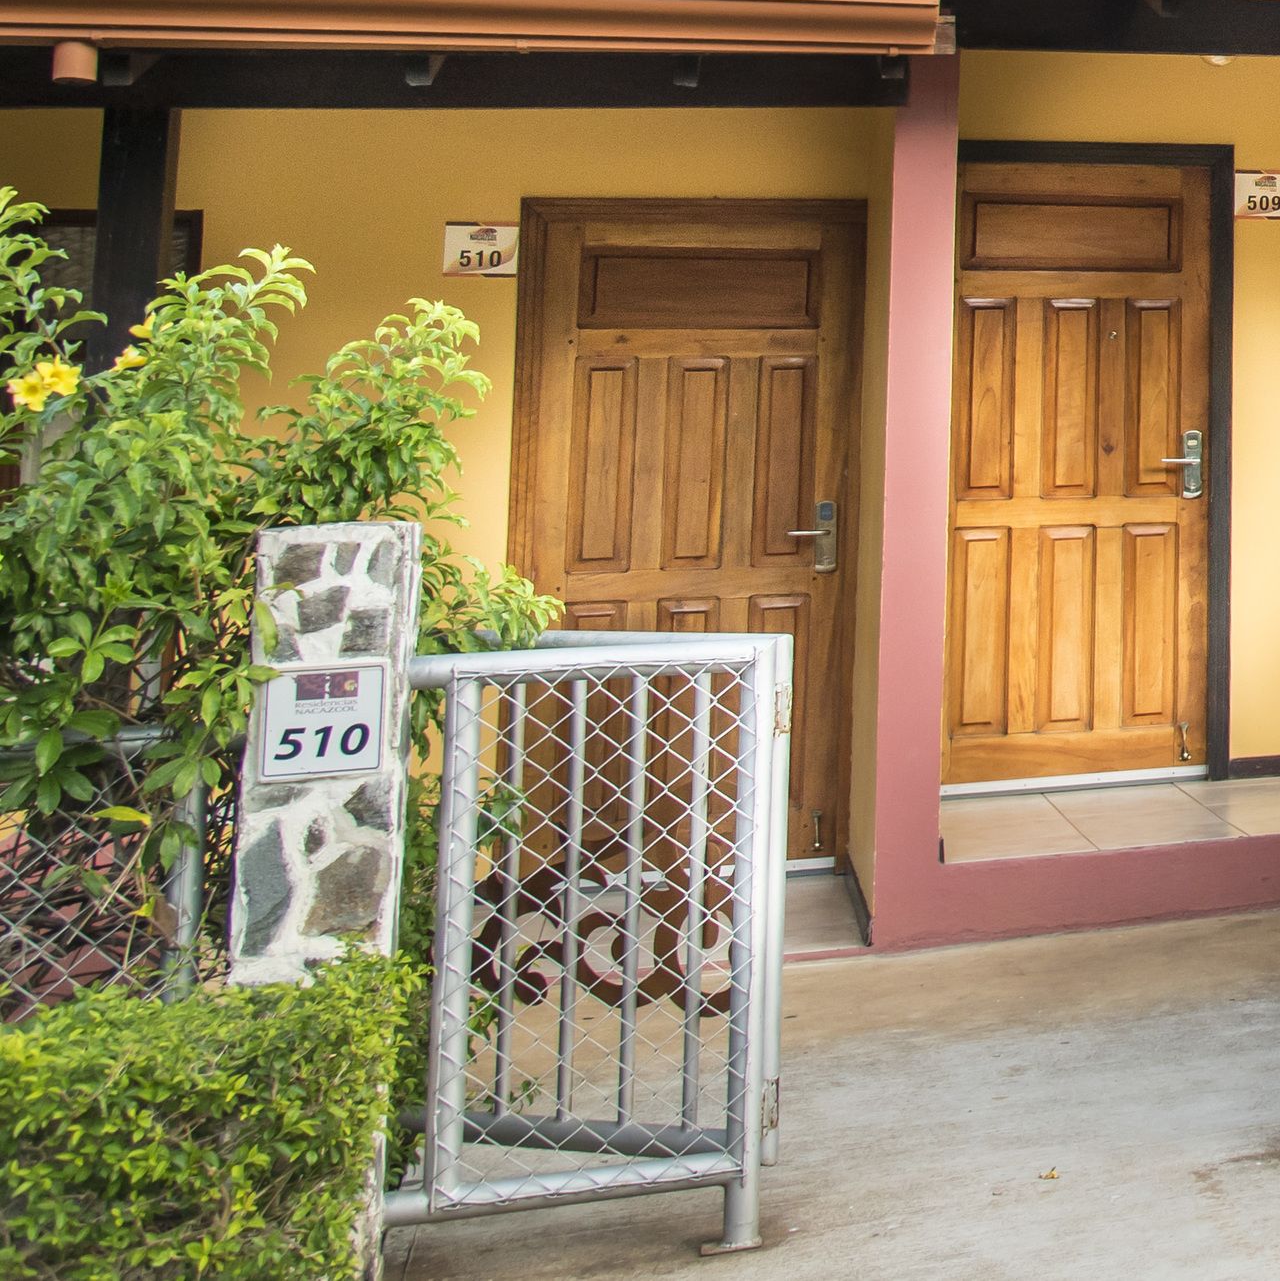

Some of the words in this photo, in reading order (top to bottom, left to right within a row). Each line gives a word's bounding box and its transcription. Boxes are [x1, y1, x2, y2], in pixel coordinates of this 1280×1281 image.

[459, 250, 502, 268] 510
[295, 699, 358, 709] Residencias
[295, 706, 358, 715] NACAZCOL
[273, 723, 370, 761] 510
